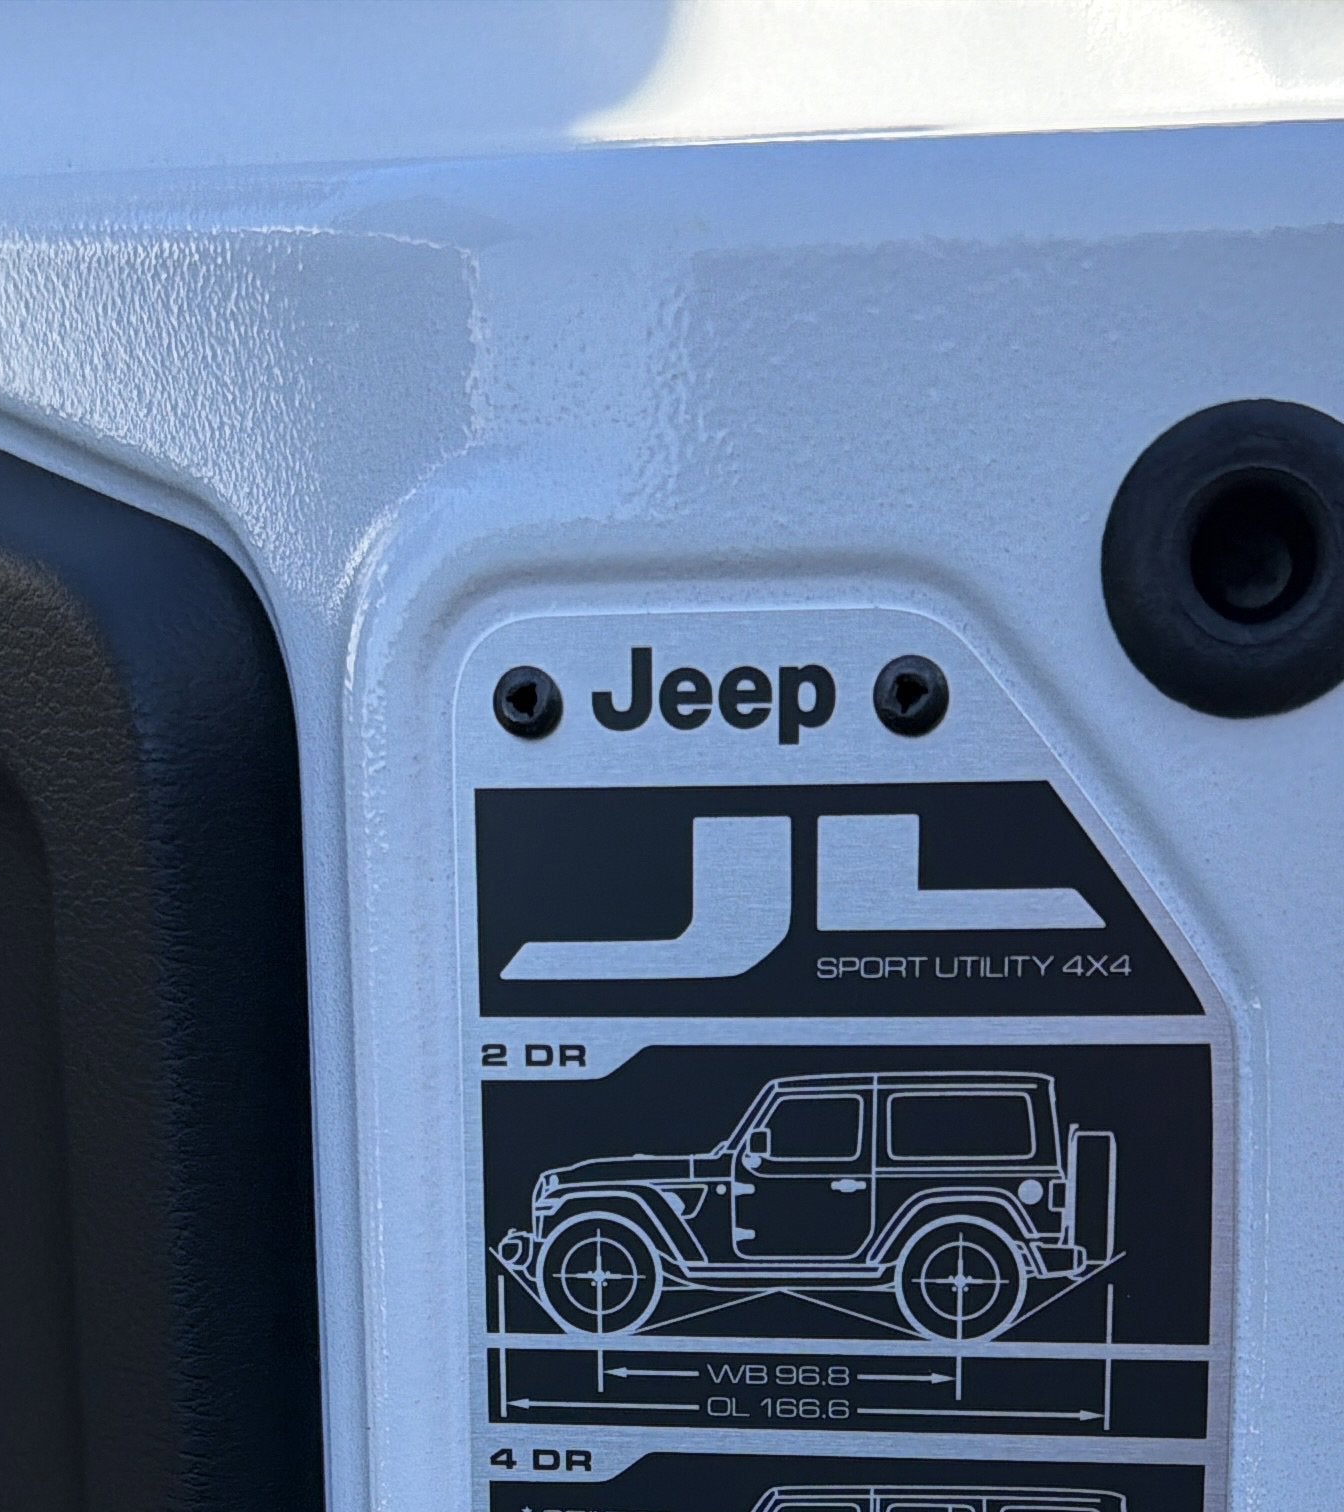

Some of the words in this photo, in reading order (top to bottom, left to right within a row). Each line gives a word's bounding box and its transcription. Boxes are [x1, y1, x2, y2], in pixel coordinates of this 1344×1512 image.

[591, 645, 837, 746] Jeep
[499, 812, 1107, 981] JL
[816, 954, 927, 980] SPORT
[935, 954, 1054, 980] UTILITY
[1061, 953, 1133, 978] 4X4
[480, 1043, 509, 1067] 2
[524, 1043, 587, 1067] DR
[706, 1363, 768, 1385] WB
[775, 1364, 851, 1386] 96.8
[706, 1396, 751, 1417] OL
[759, 1397, 851, 1419] 166.6
[489, 1447, 517, 1470] 4
[532, 1448, 593, 1472] DR
